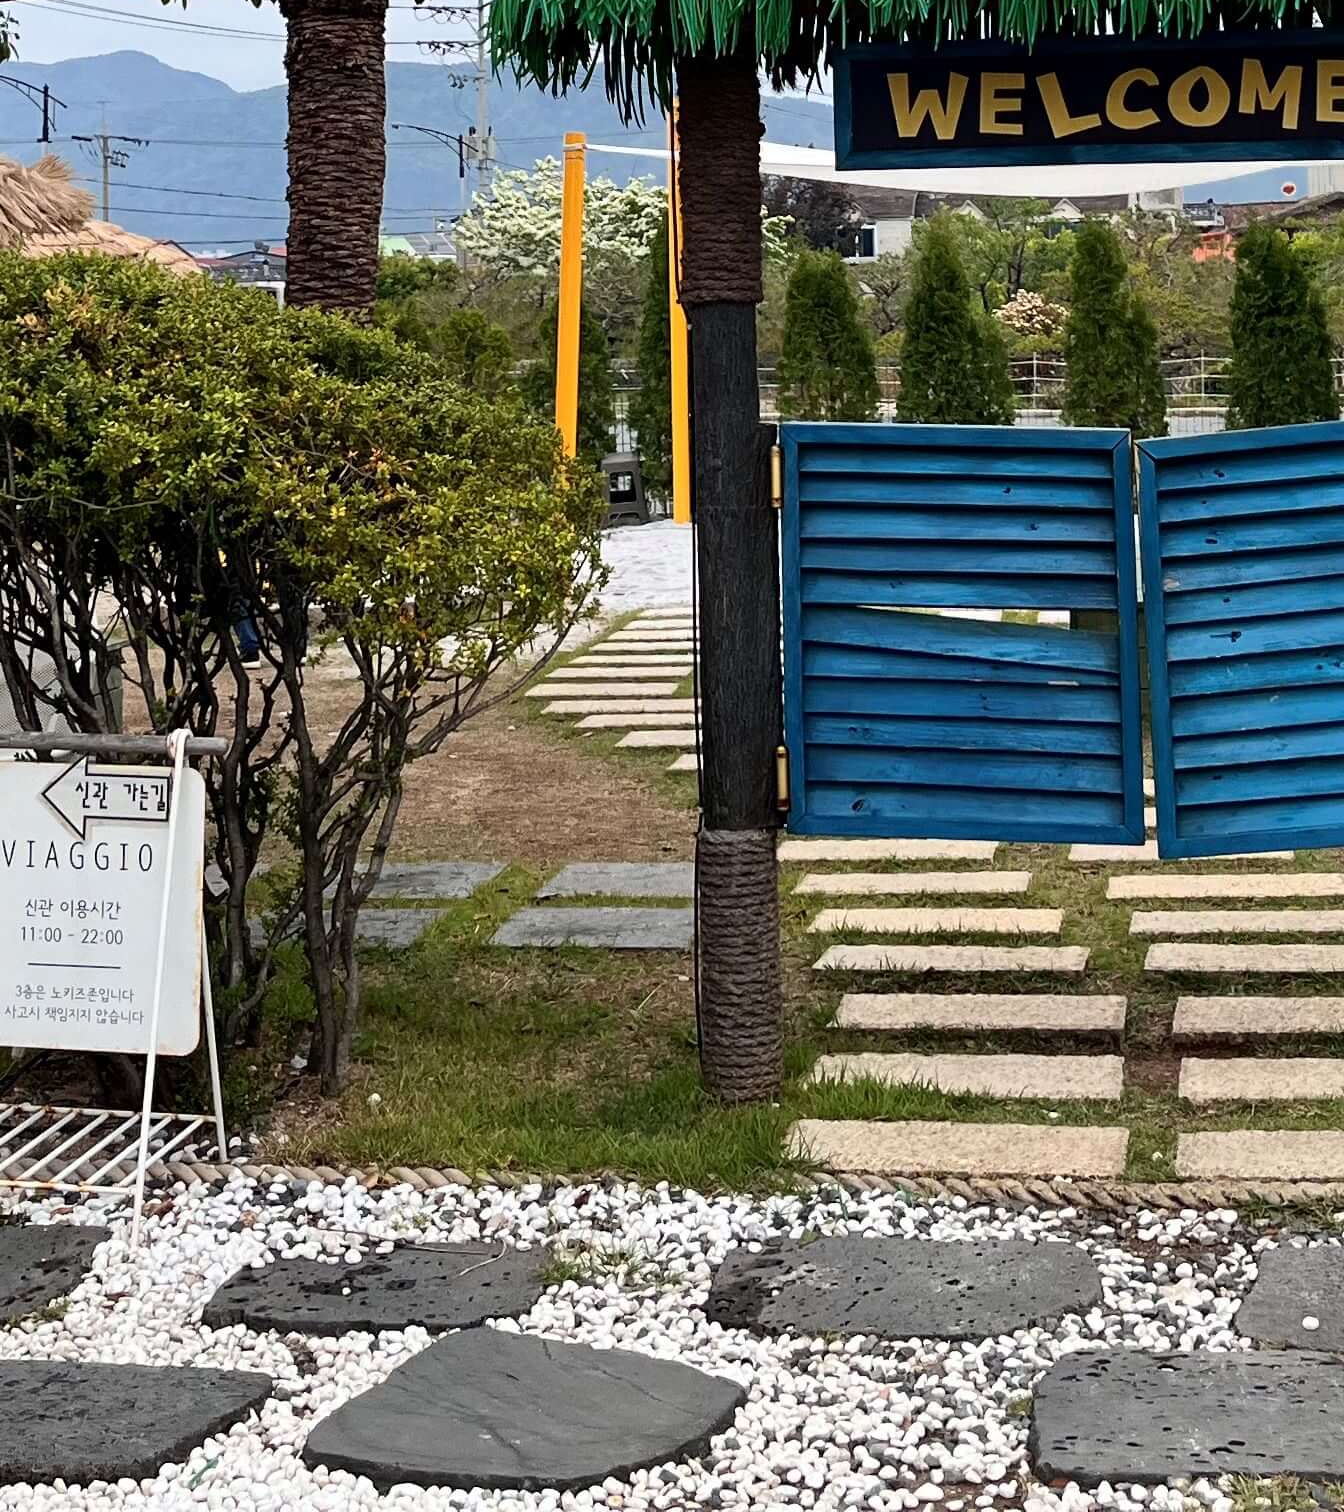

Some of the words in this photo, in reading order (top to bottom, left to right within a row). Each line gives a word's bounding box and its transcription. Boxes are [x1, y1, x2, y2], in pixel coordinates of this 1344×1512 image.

[75, 781, 109, 810] 신관
[123, 782, 166, 813] 가는길
[2, 839, 153, 872] VIAGGIO
[25, 899, 54, 918] 신관
[60, 900, 121, 920] 이용시간
[21, 926, 62, 943] 11:00
[81, 928, 124, 945] 22:00
[16, 984, 46, 1001] 3층은
[51, 986, 135, 1003] 노키즈존입니다
[5, 1005, 40, 1021] 사고시
[45, 1007, 91, 1023] 책임지지
[96, 1009, 145, 1025] 않습니다
